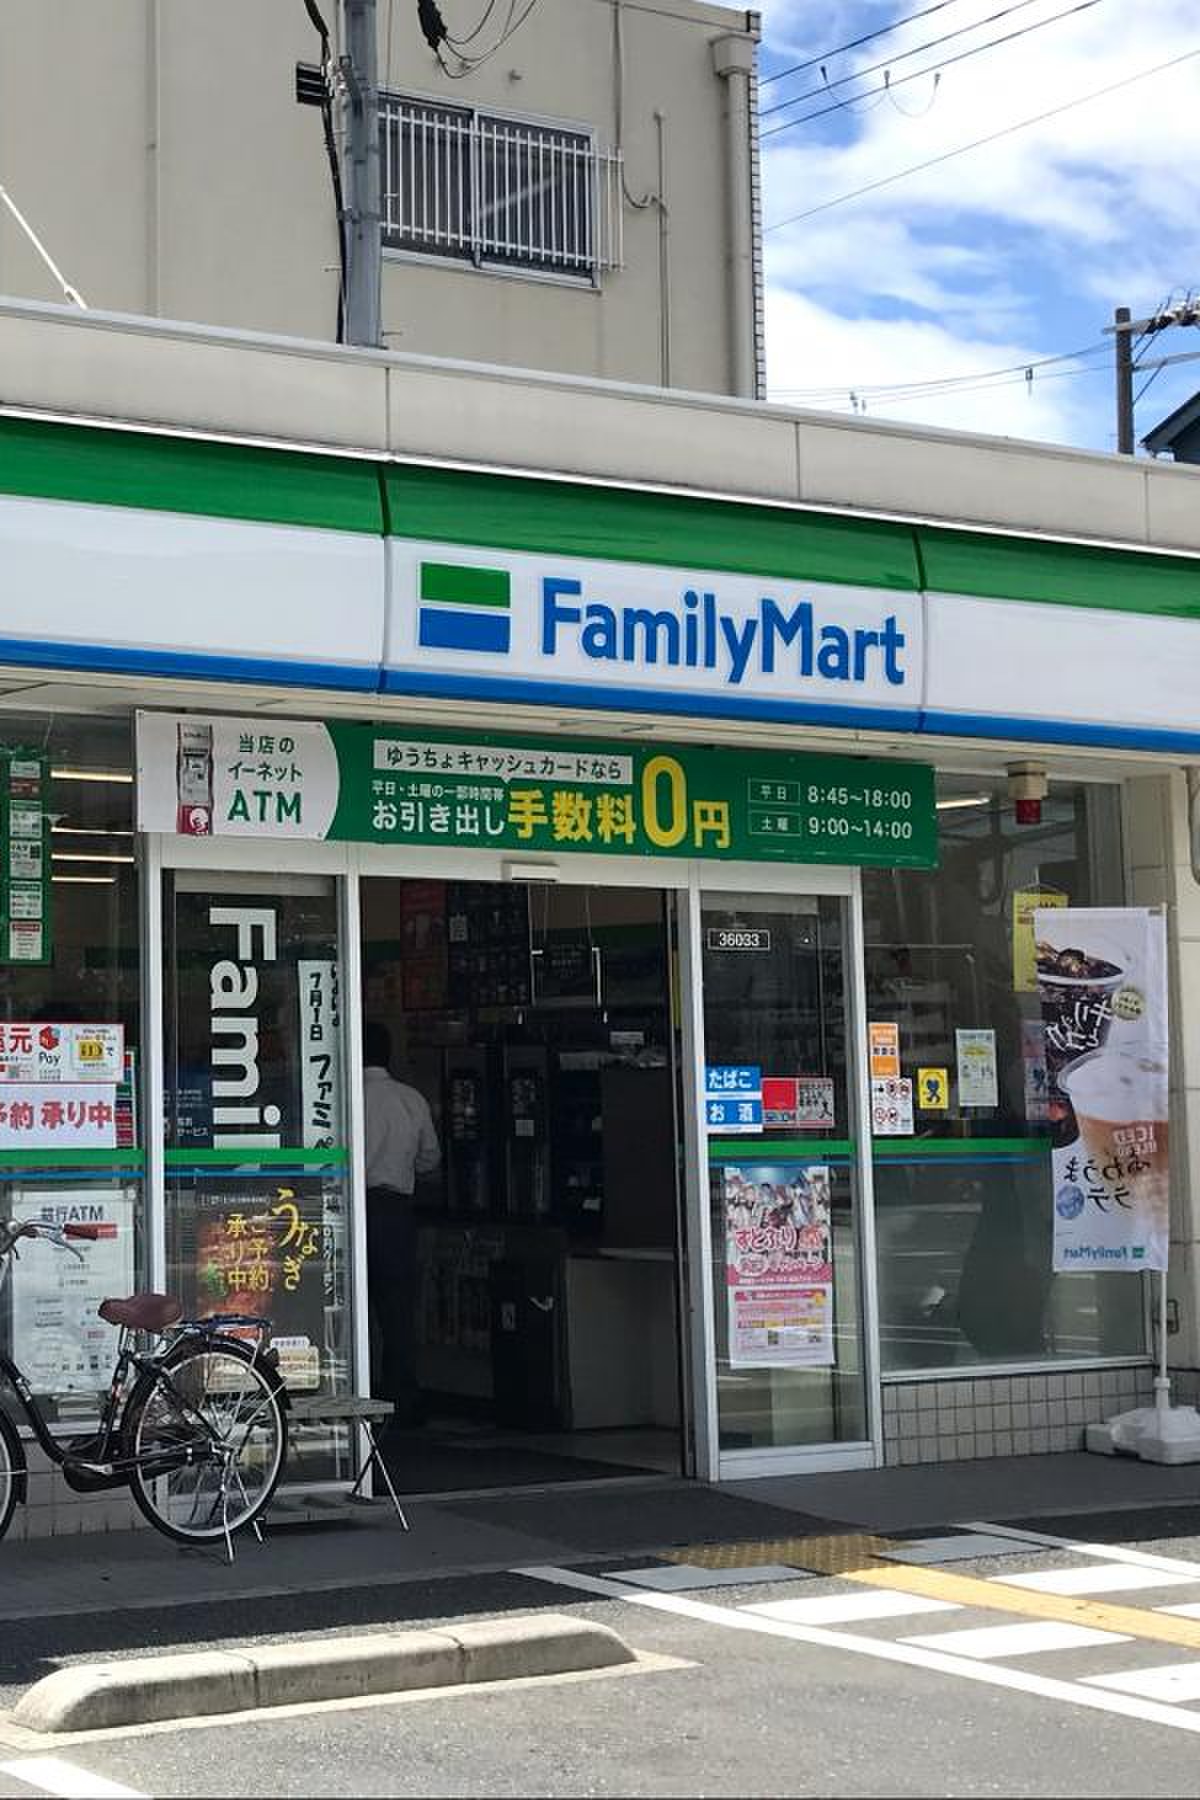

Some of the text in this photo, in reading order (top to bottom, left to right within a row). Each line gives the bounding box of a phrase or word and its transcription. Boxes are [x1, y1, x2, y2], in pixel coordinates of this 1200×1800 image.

[541, 576, 905, 685] FamilyMart
[238, 735, 295, 754] 当店の
[227, 761, 303, 783] イーネット
[386, 747, 622, 781] ゆうちょキャッシュカードなら
[761, 785, 786, 800] 平日
[227, 790, 302, 824] ATM
[372, 800, 506, 836] お引き出し
[761, 816, 789, 832] 土曜
[719, 932, 760, 948] 36033
[309, 972, 323, 1041] 7月1日
[708, 1071, 753, 1089] たばこ
[41, 1101, 112, 1130] 承り中
[709, 1102, 754, 1123] お酒
[272, 1187, 320, 1291] うなぎ
